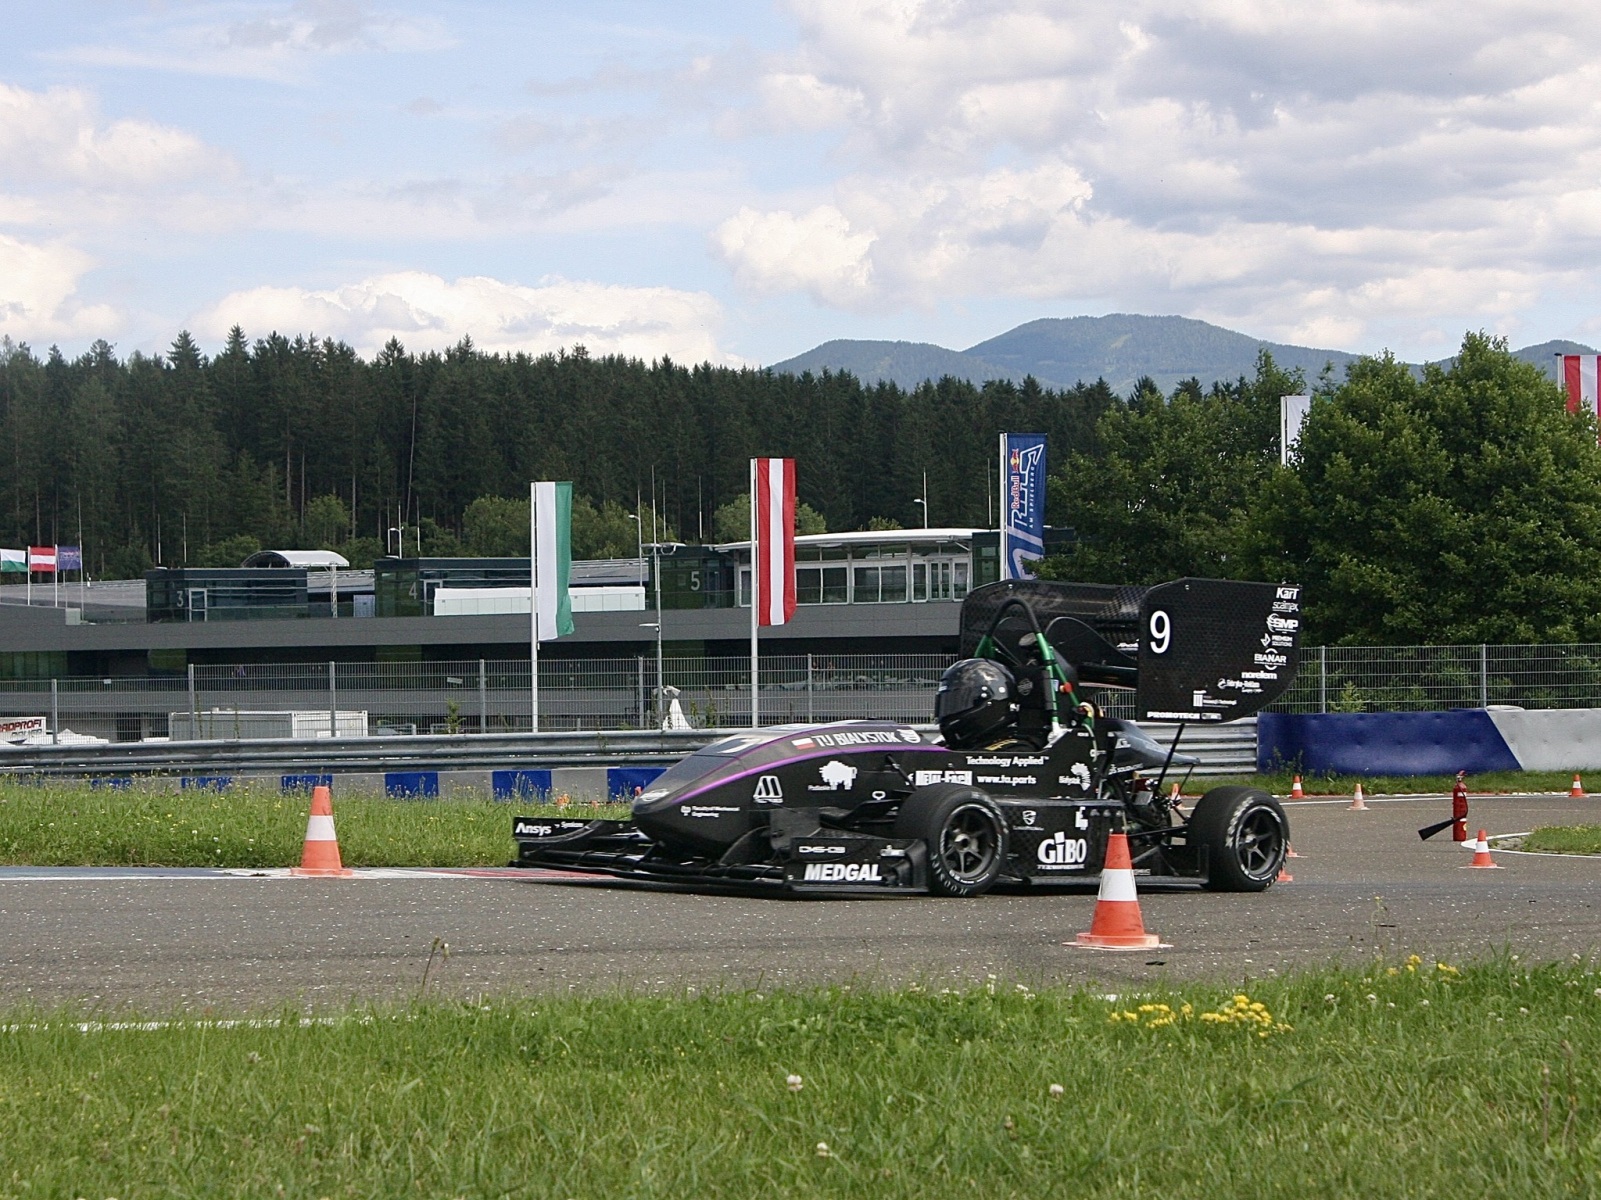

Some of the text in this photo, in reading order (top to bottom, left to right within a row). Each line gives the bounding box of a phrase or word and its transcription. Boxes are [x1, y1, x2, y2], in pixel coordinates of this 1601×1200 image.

[690, 570, 701, 591] 5
[176, 590, 184, 607] 3
[408, 581, 418, 600] 4
[1149, 610, 1171, 654] 9
[966, 756, 1011, 767] Technology
[515, 822, 552, 836] Ansys
[804, 863, 882, 881] MEDGAL
